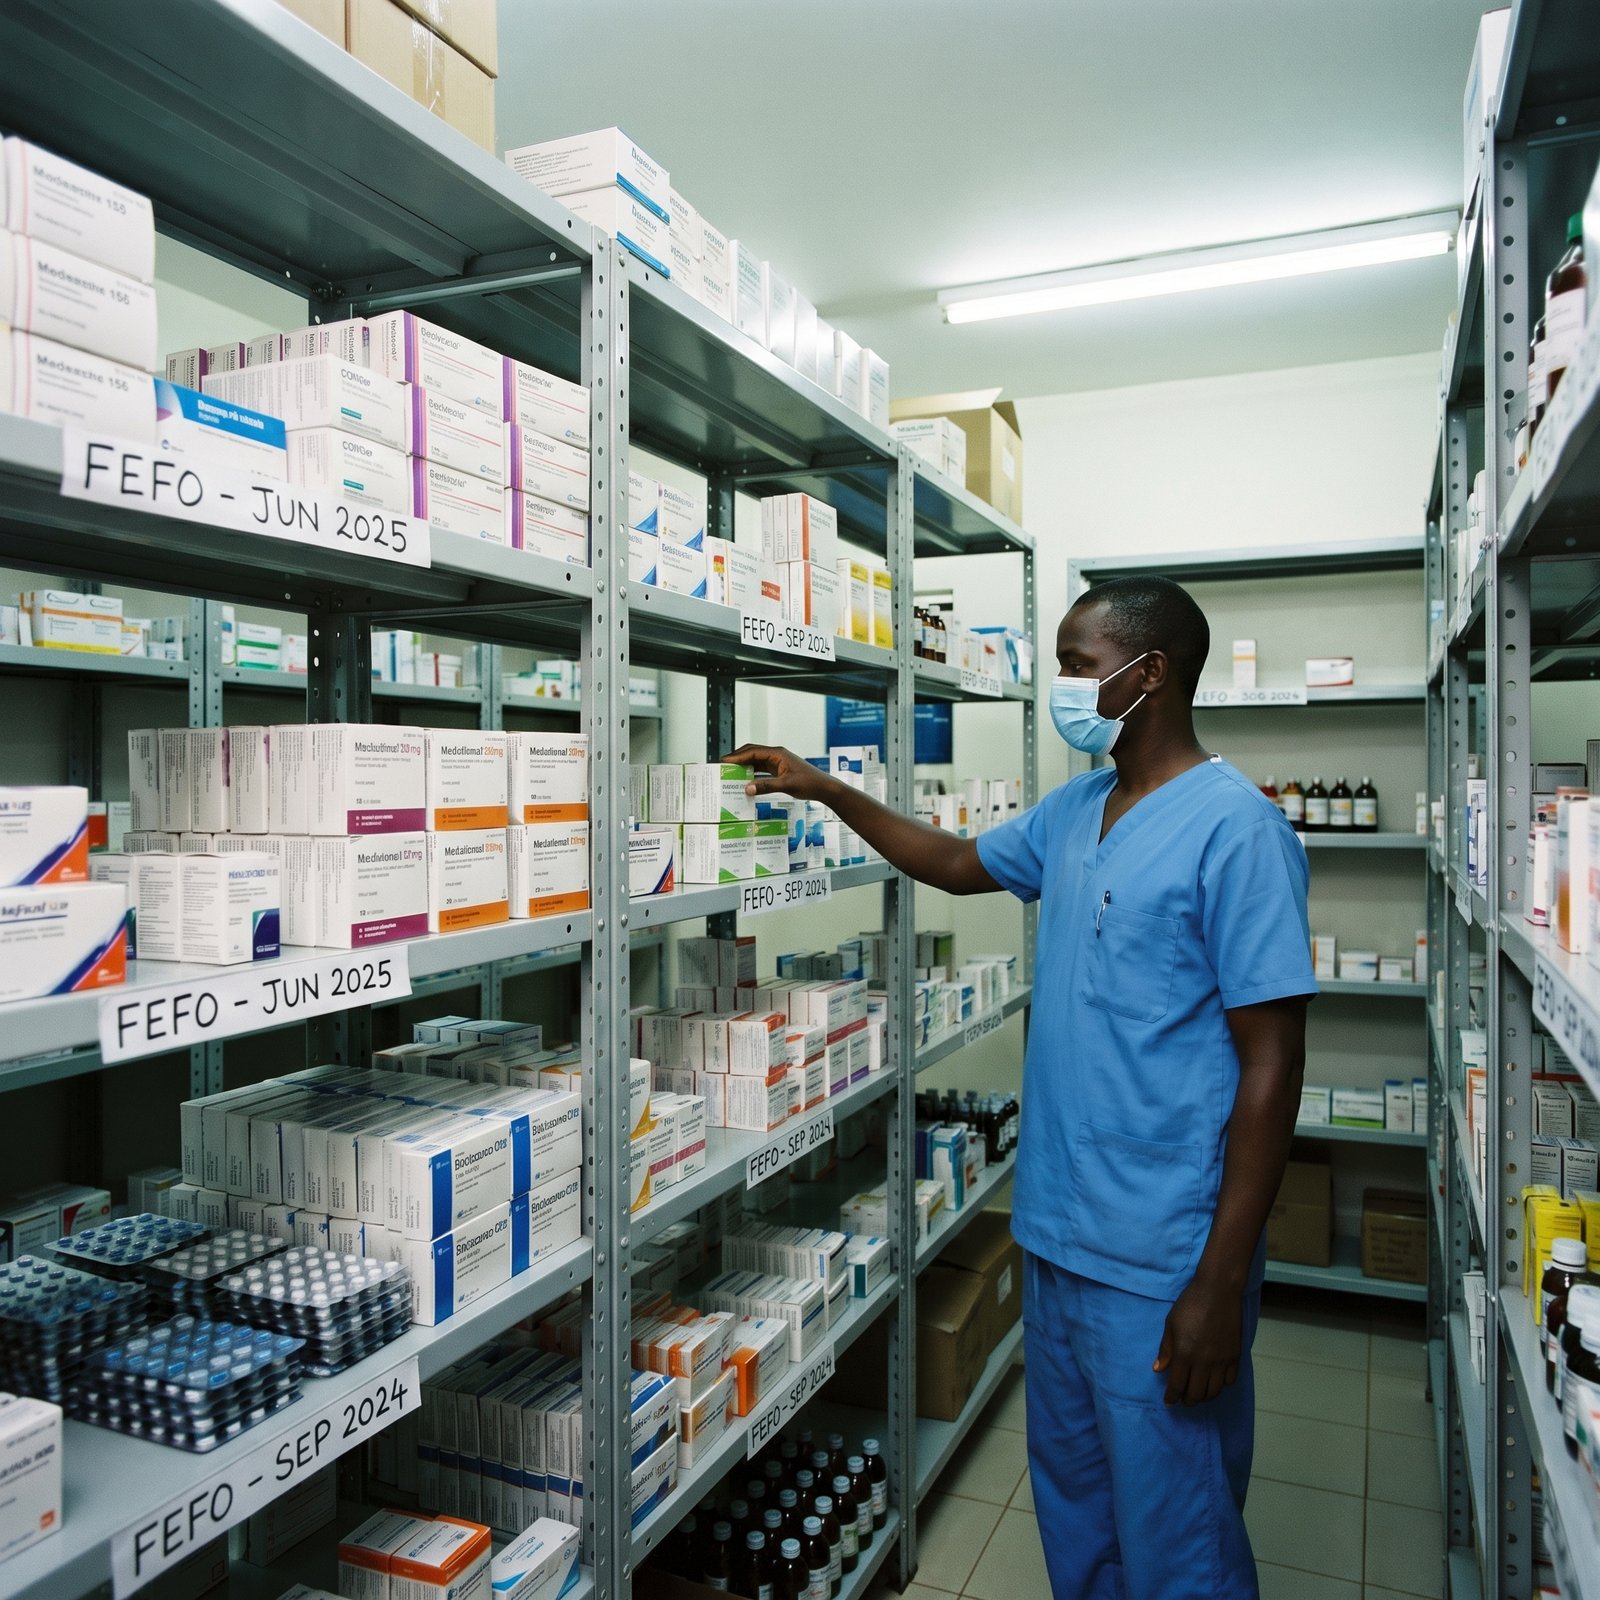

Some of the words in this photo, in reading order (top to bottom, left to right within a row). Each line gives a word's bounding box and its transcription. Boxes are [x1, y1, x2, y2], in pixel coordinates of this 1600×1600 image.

[84, 442, 203, 507] FEFO
[251, 486, 319, 532] JUN
[336, 506, 407, 553] 2025
[743, 616, 775, 643] FEFO
[785, 626, 805, 648] SEP
[808, 633, 831, 655] 2024
[744, 887, 774, 912] FEFO
[785, 880, 803, 902] SEP
[805, 878, 828, 898] 2024
[117, 992, 218, 1048] FEFO
[262, 973, 319, 1014] JUN
[331, 959, 392, 997] 2025
[750, 1147, 778, 1182] FEFO
[788, 1130, 806, 1156] SEP
[809, 1116, 831, 1146] 2024
[751, 1405, 781, 1448] FEFO
[789, 1379, 807, 1411] SEP
[809, 1355, 833, 1391] 2024
[135, 1482, 233, 1577] FEFO
[275, 1418, 331, 1481] SEP
[342, 1377, 408, 1439] 2024
